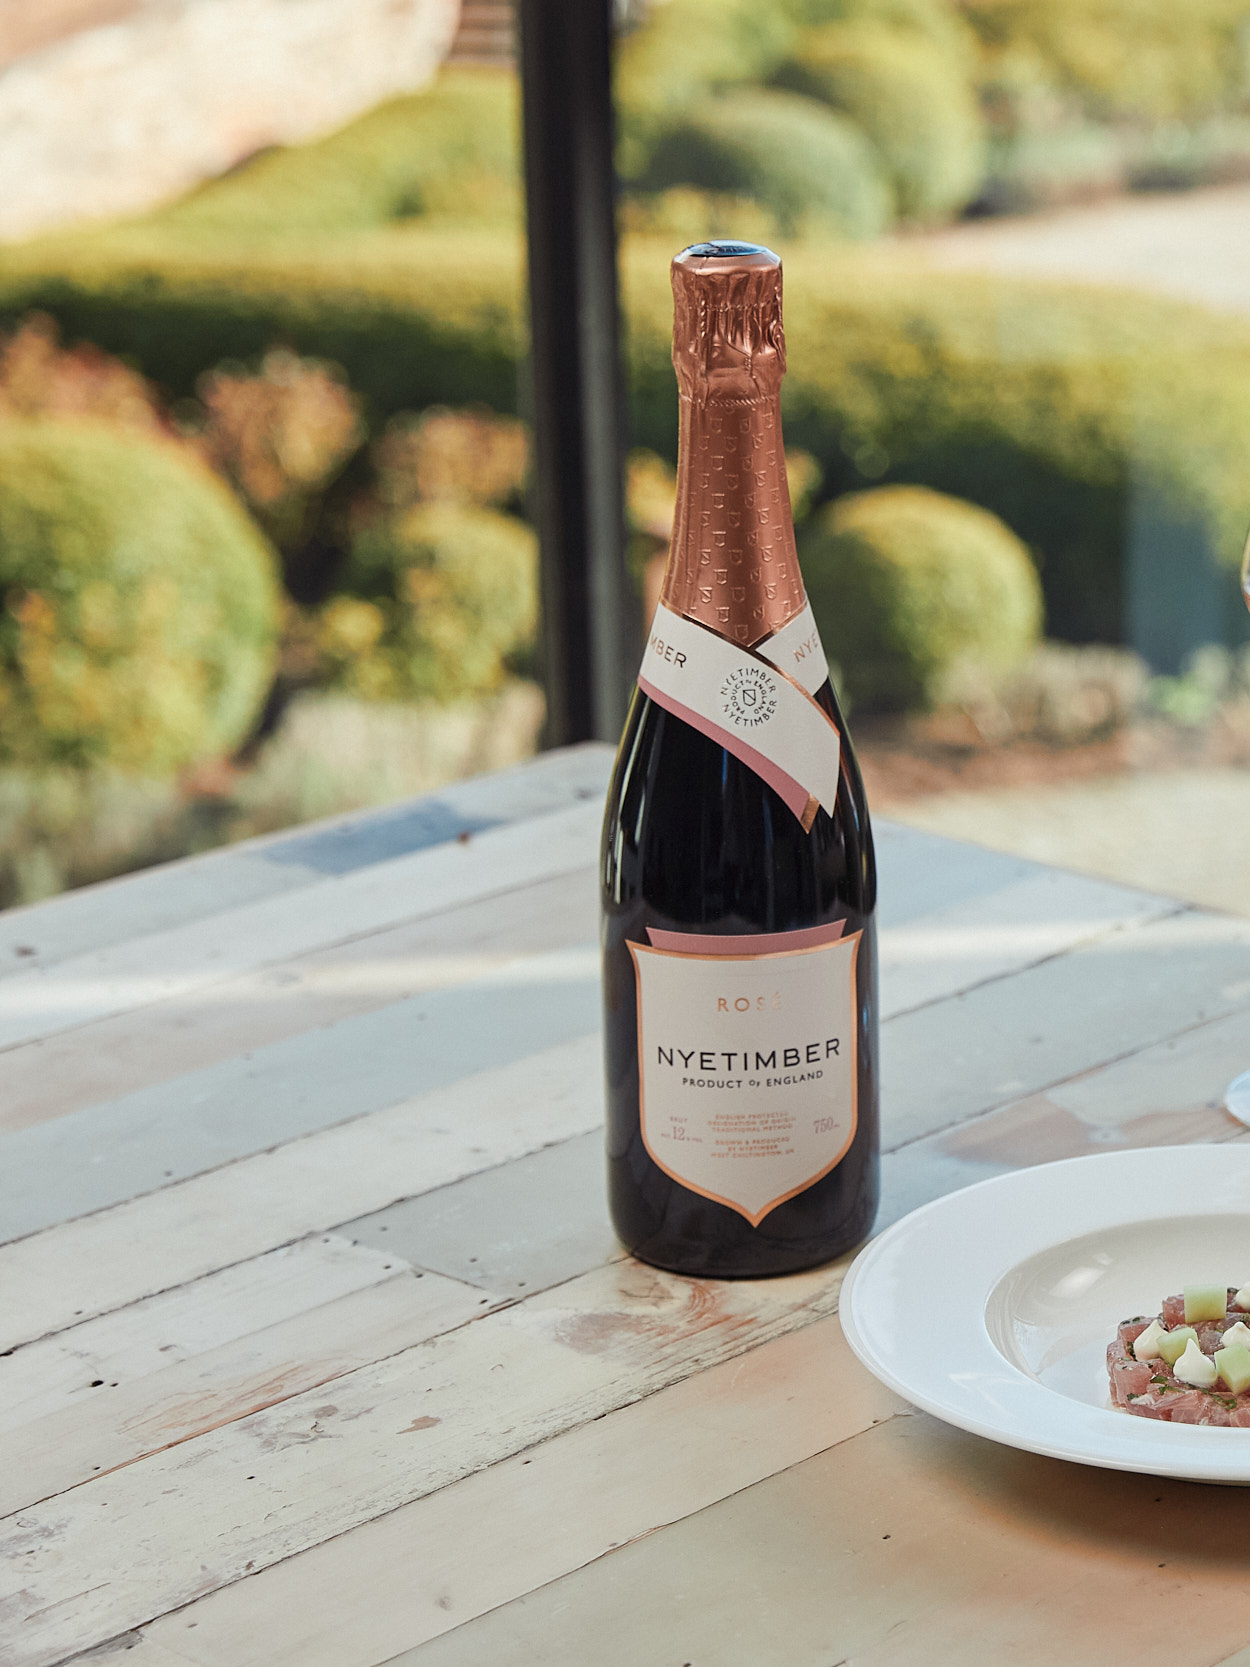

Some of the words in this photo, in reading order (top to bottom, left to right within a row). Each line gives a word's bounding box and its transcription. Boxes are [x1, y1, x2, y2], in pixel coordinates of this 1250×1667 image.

[720, 668, 776, 696] NYETIMBER
[721, 700, 777, 727] NYETIMBER
[657, 1038, 841, 1072] NYETIMBER
[682, 1077, 742, 1089] PRODUCT
[766, 1070, 824, 1088] ENGLAND
[673, 1126, 685, 1141] 12
